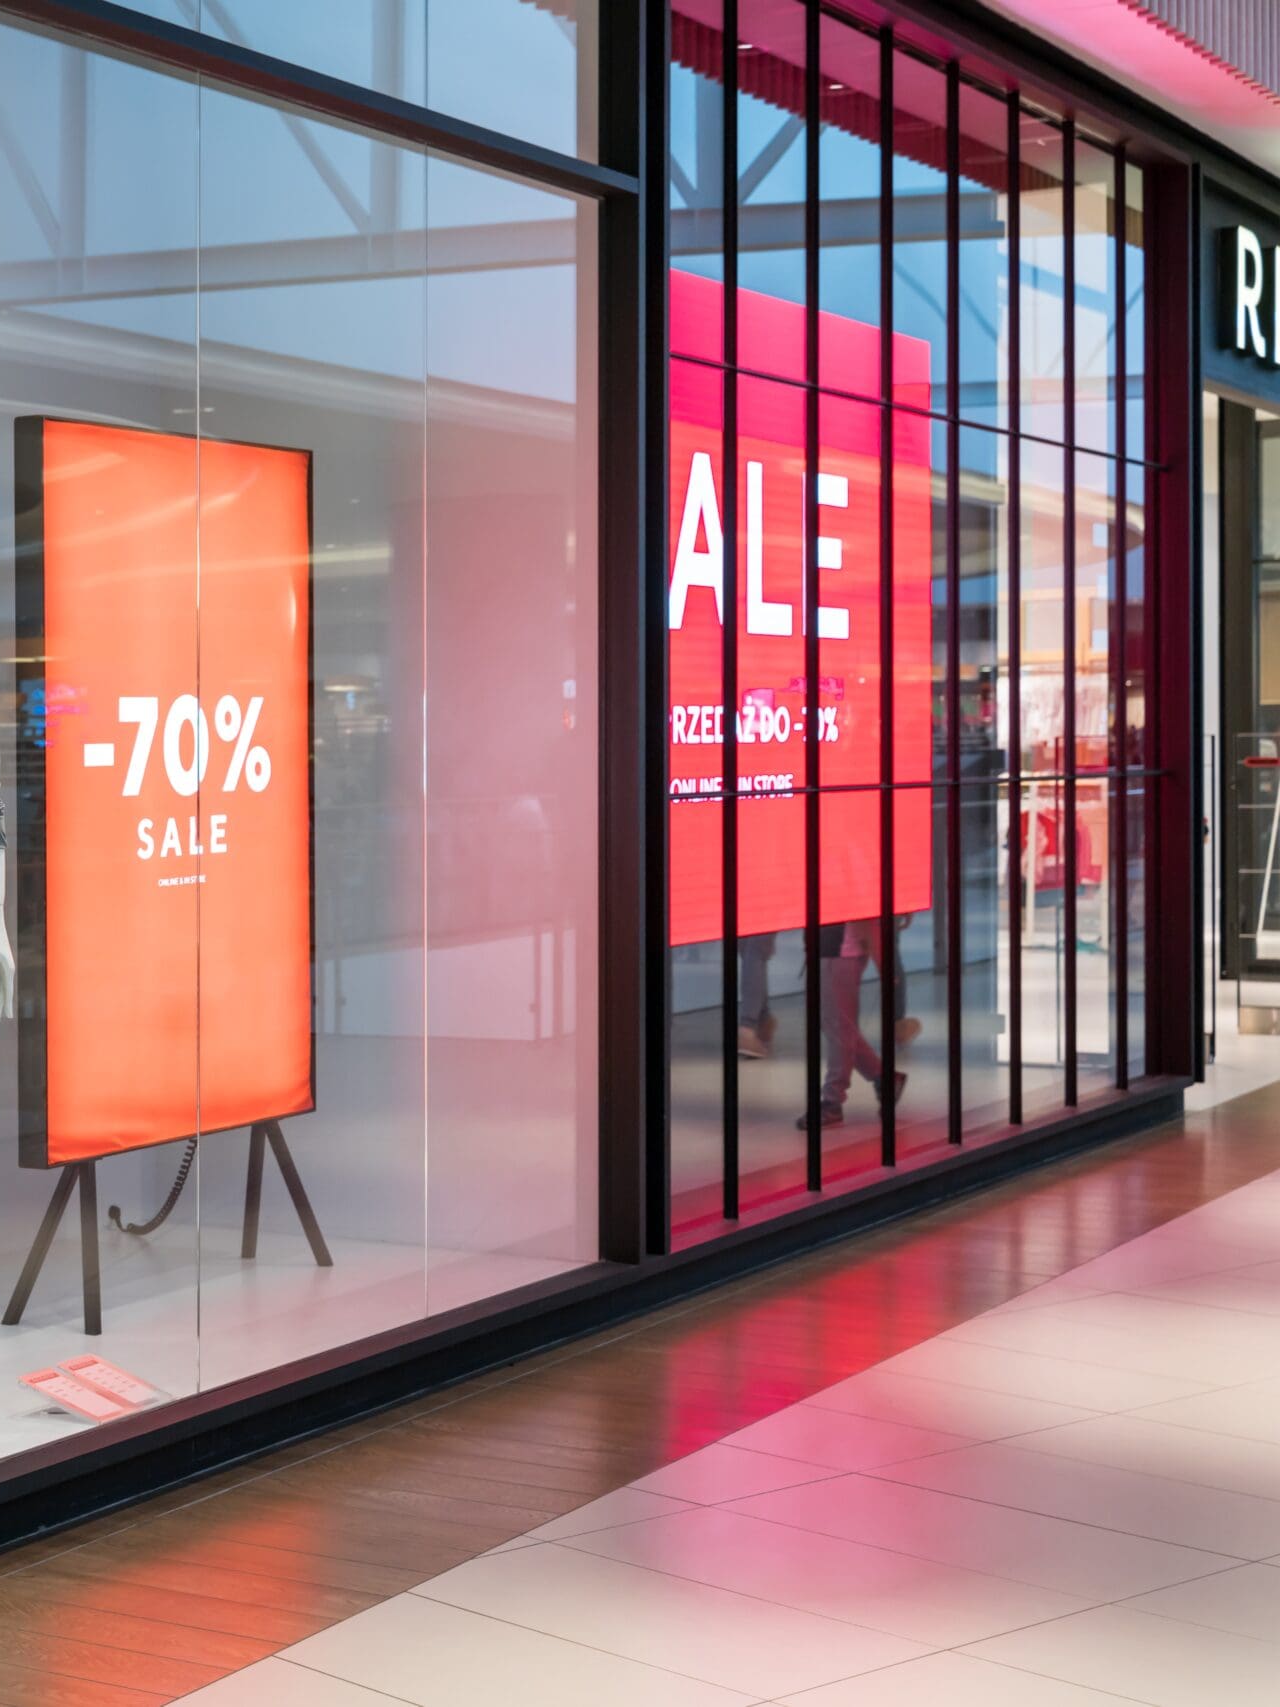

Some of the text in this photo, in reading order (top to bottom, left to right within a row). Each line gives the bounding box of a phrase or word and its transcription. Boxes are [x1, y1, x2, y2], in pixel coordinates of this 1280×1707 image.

[759, 706, 791, 743] DO
[83, 694, 271, 797] -70%
[670, 777, 723, 804] ONLINE
[137, 814, 228, 860] SALE
